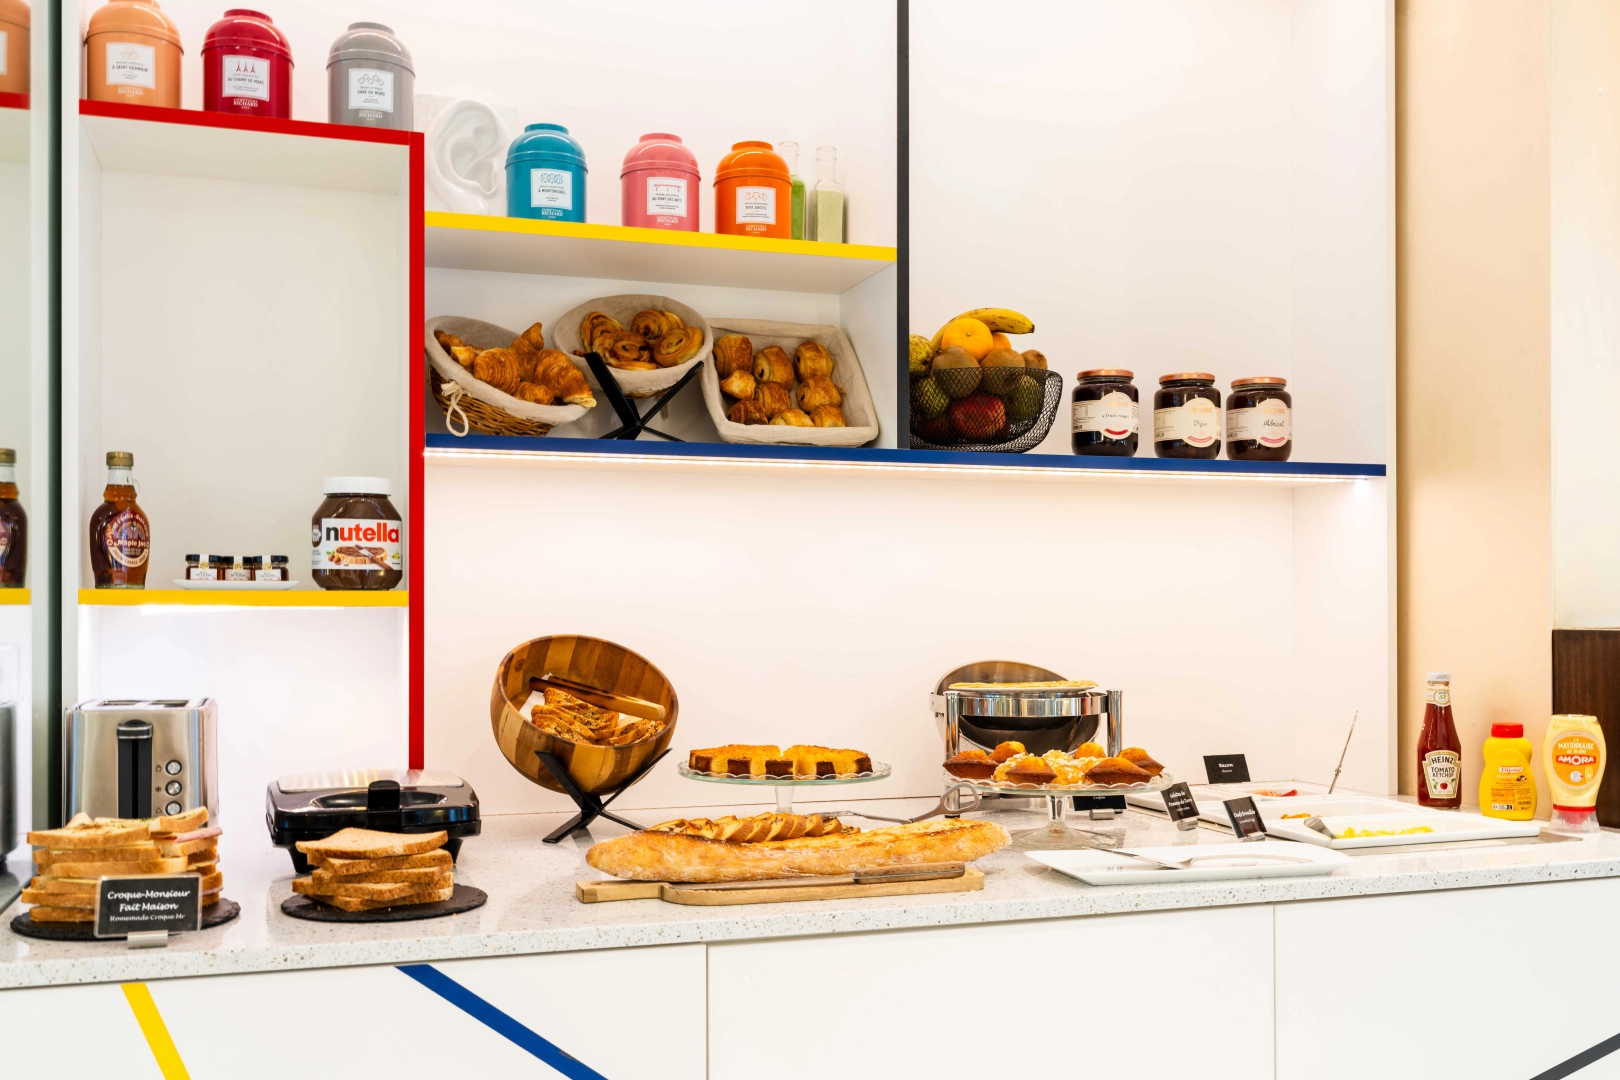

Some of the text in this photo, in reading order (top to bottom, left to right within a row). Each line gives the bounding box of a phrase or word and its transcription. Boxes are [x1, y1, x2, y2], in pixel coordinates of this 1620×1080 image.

[1262, 419, 1285, 427] Abricot
[326, 522, 399, 543] nutella
[1558, 742, 1595, 750] MAYONNAISE
[1431, 756, 1454, 764] HEINZ
[1558, 756, 1594, 765] AMORA
[108, 890, 190, 901] Croque-Monsieur
[120, 902, 179, 912] Fait Maison
[150, 914, 174, 922] Croque
